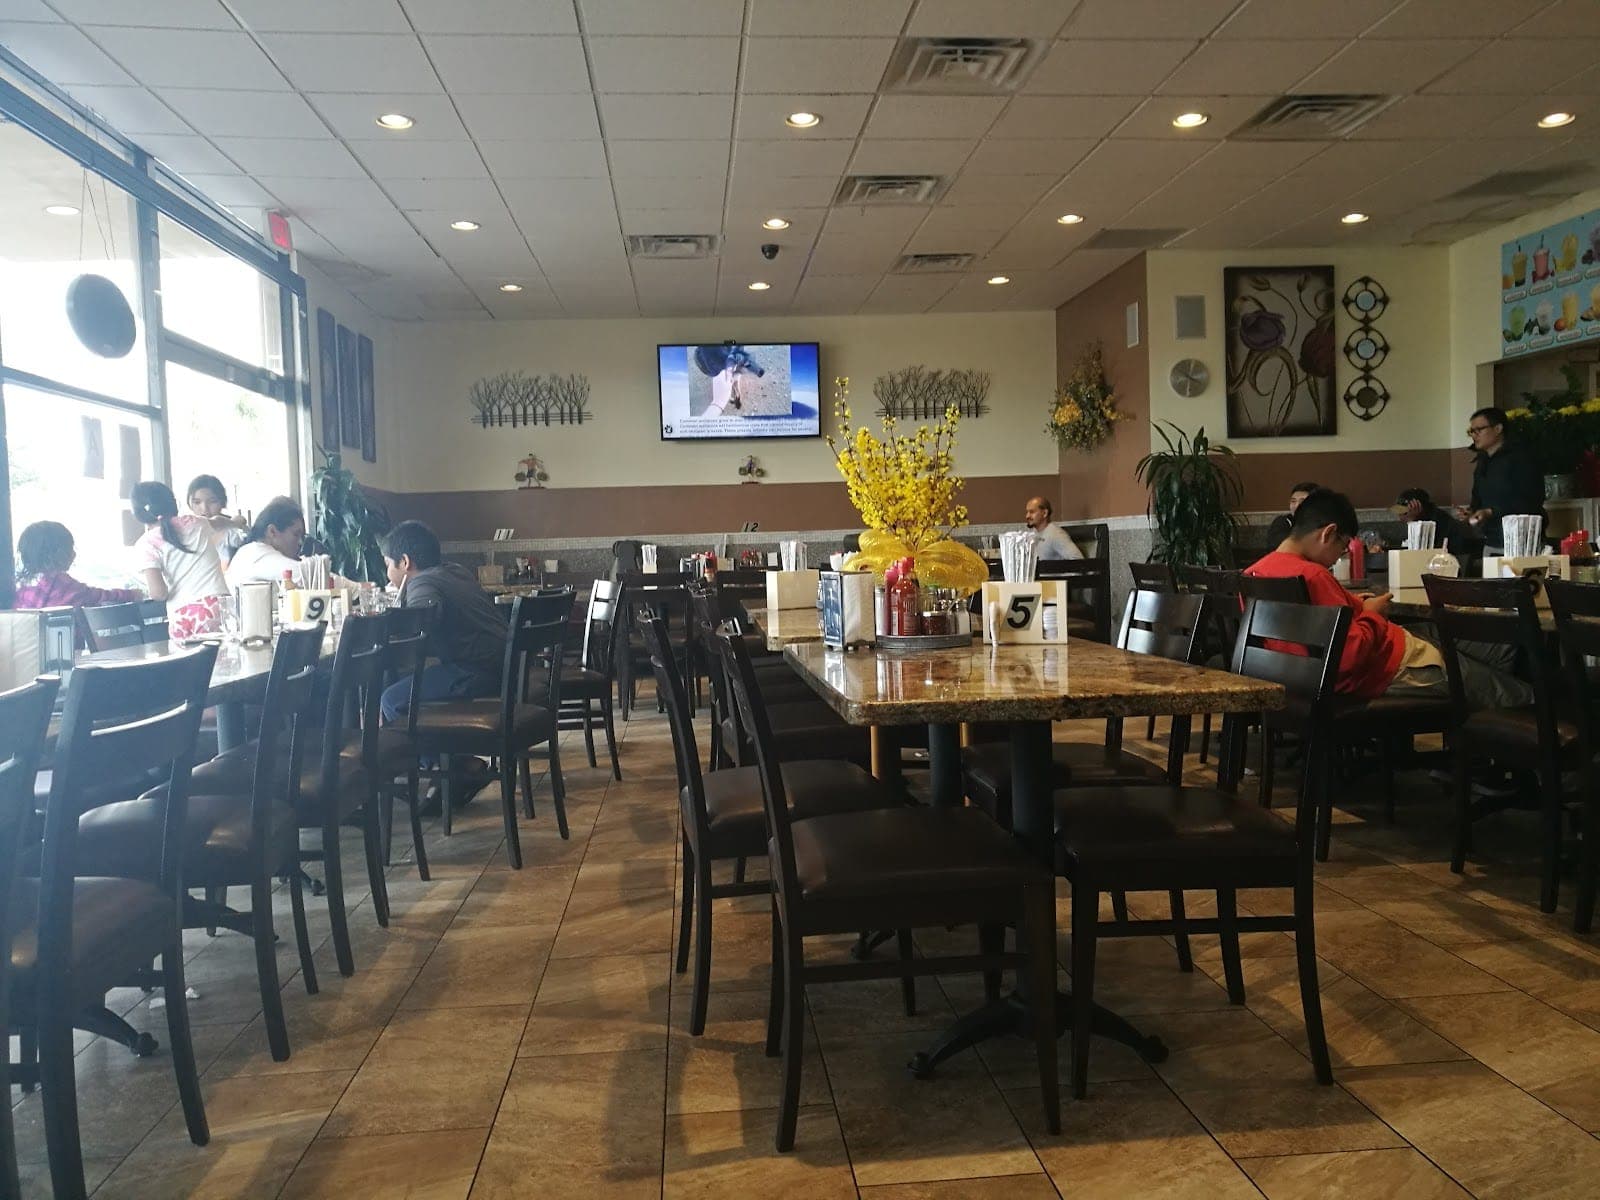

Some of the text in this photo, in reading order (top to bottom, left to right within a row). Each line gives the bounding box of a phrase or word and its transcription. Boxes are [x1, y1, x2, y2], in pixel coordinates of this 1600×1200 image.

[744, 522, 759, 533] 12
[308, 598, 325, 620] 9
[1007, 596, 1034, 628] 5
